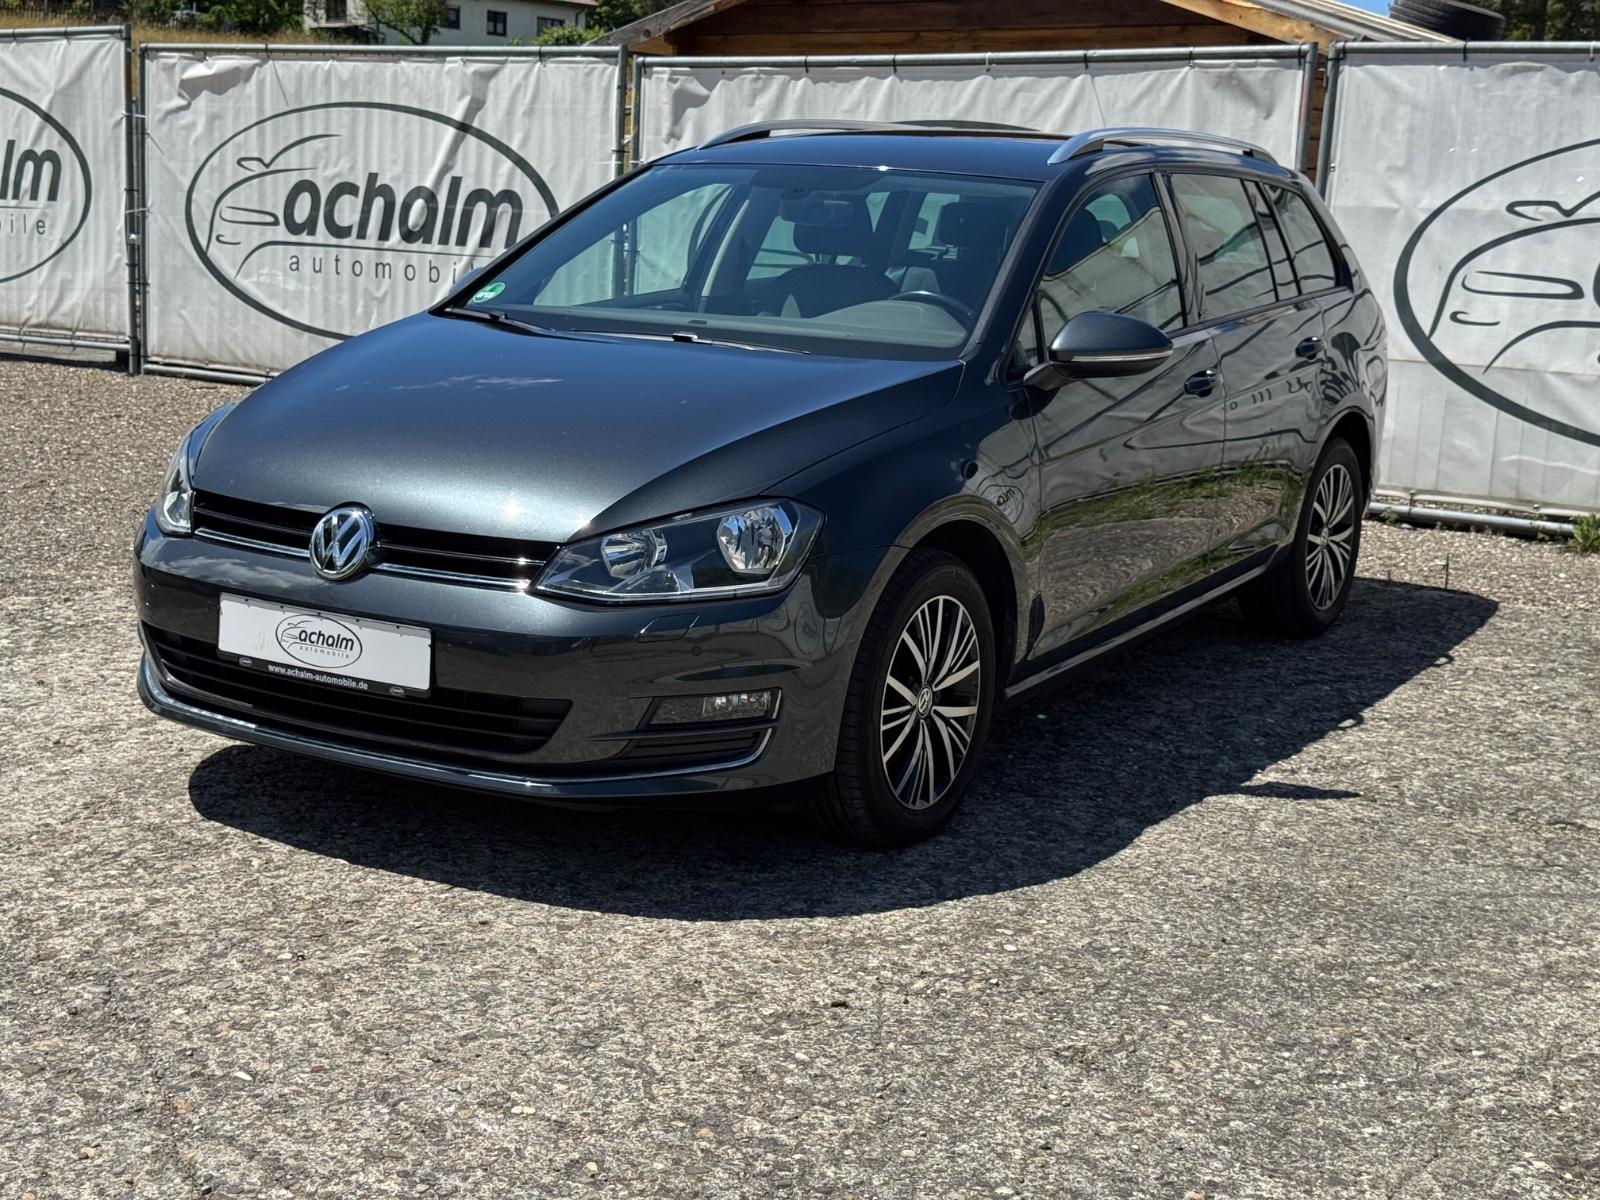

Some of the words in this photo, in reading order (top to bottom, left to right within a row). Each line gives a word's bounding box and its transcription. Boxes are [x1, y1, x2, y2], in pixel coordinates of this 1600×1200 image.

[283, 172, 523, 249] achalm
[289, 254, 474, 285] automobi
[298, 629, 355, 651] achalm
[299, 645, 349, 659] automobile
[268, 664, 368, 690] www.achalm-automobile.de
